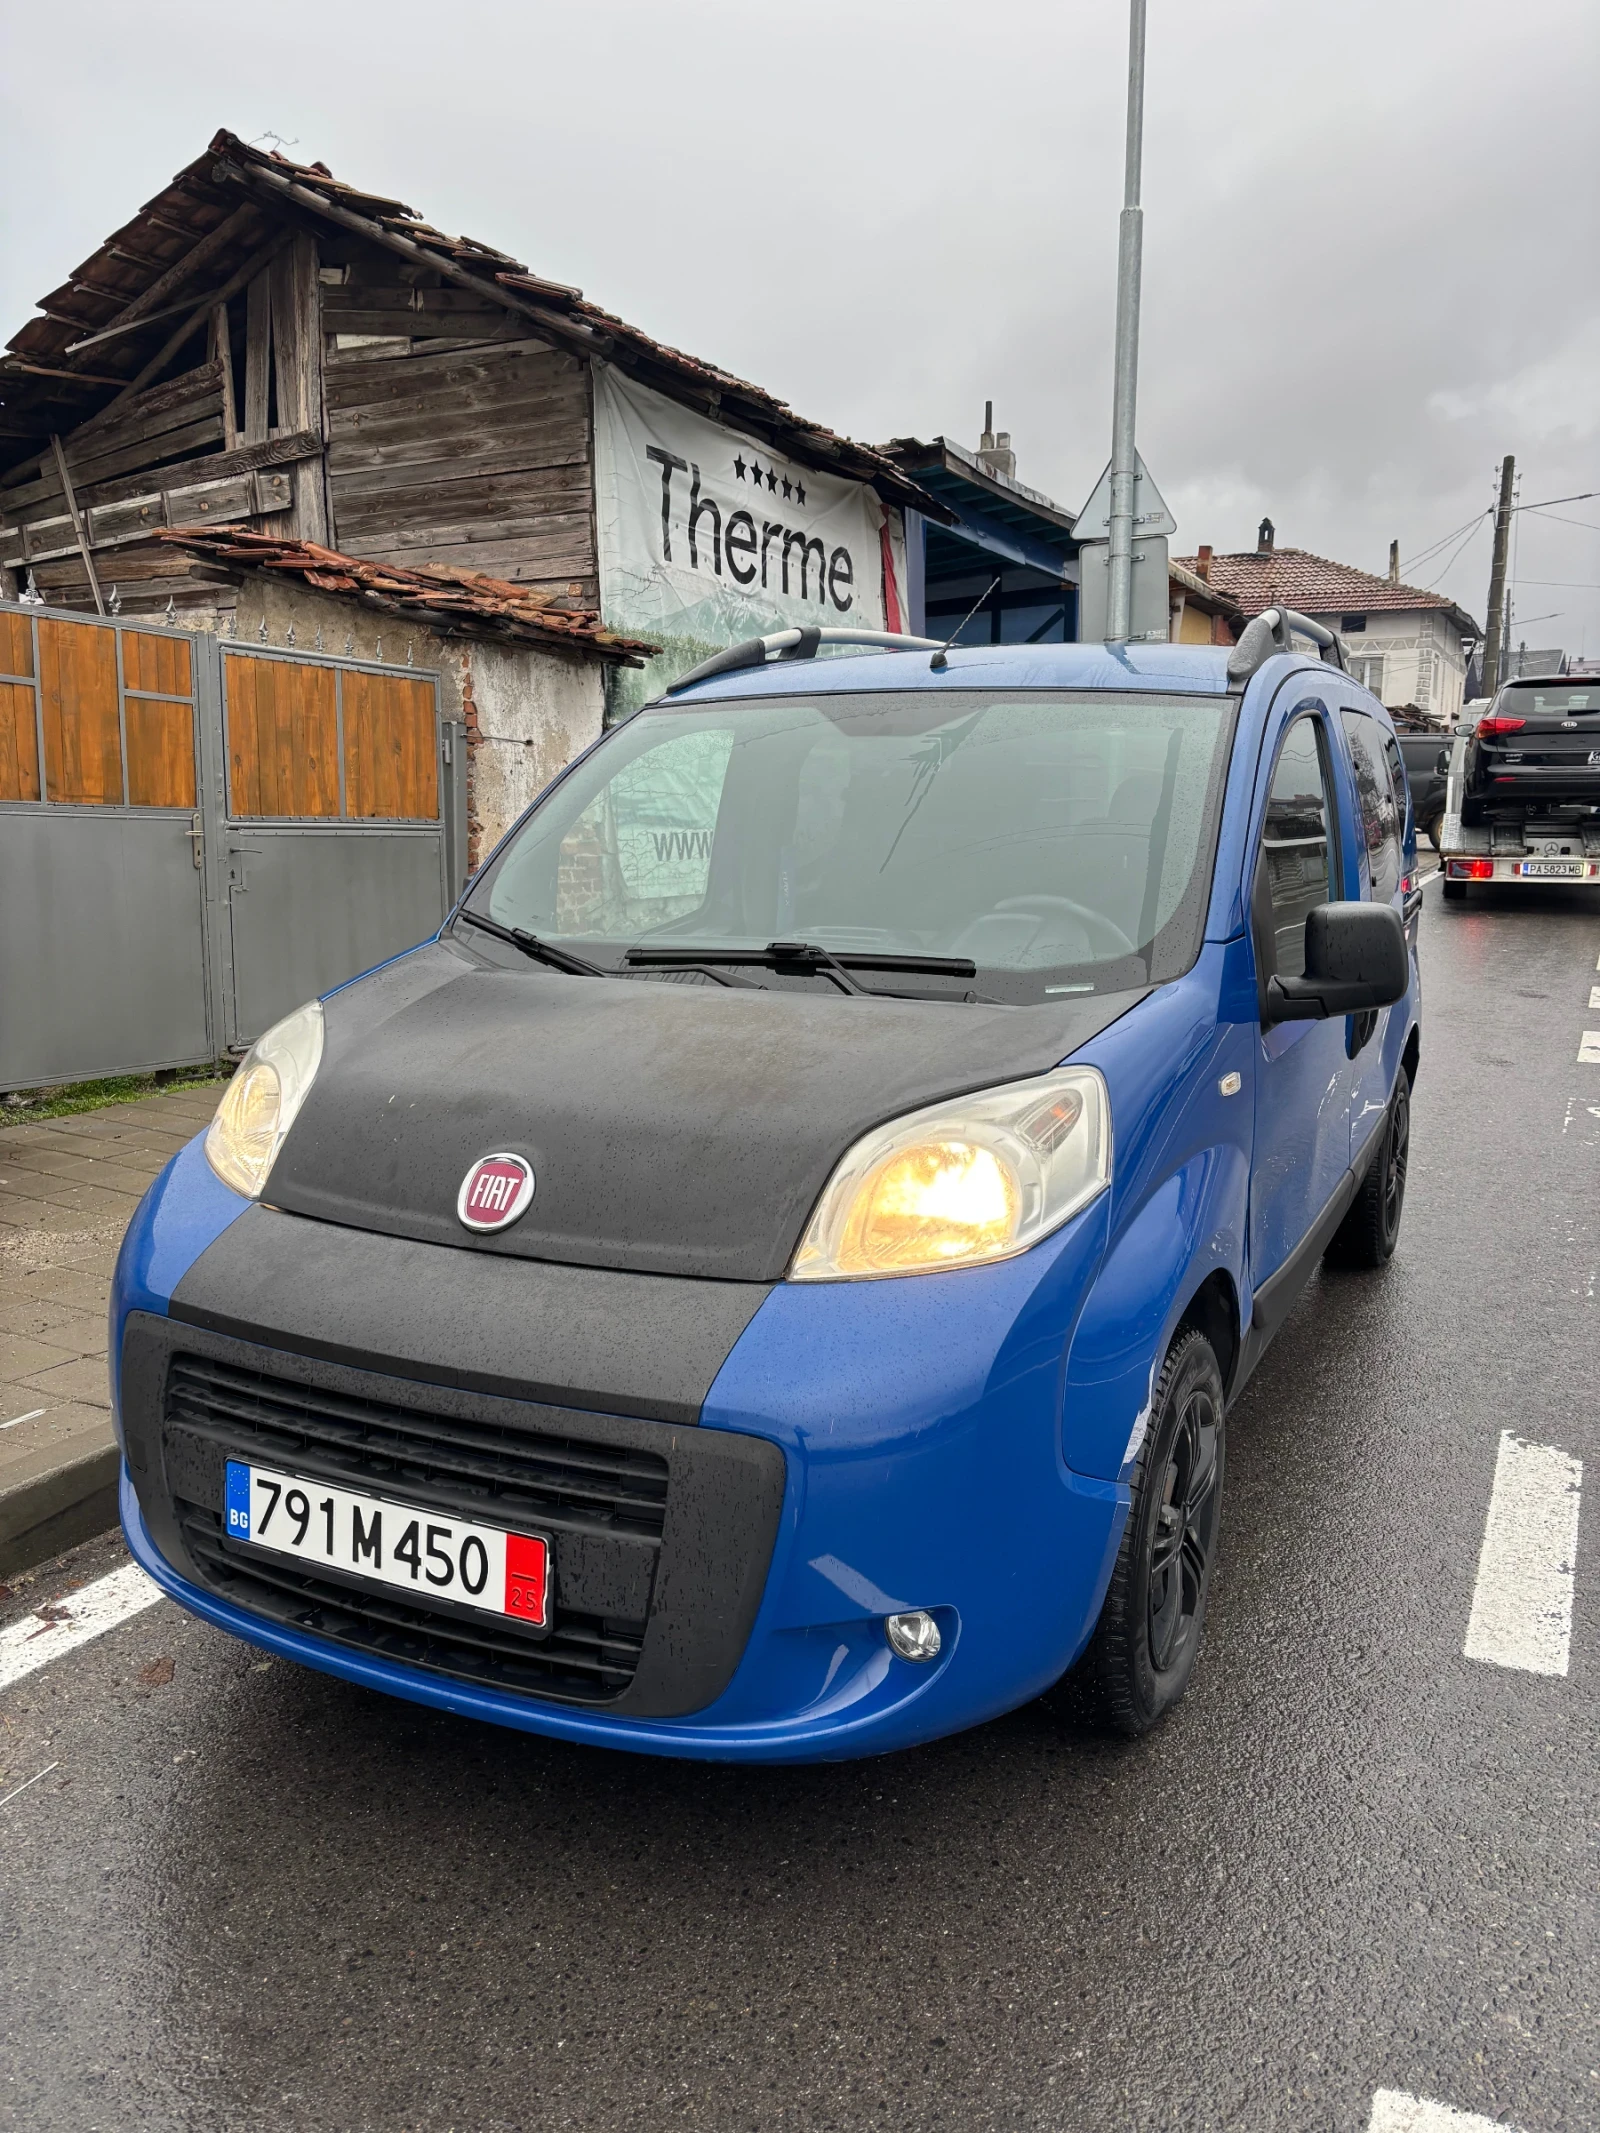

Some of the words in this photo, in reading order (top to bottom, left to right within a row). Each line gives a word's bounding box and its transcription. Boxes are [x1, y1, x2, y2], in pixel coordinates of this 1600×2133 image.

[646, 444, 854, 612] Therme
[1530, 865, 1542, 874] PA
[1544, 865, 1567, 874] 5823
[1569, 865, 1581, 875] MB
[470, 1174, 520, 1211] FIAT
[230, 1508, 248, 1529] BG
[256, 1478, 334, 1556] 791
[352, 1505, 382, 1569] M
[393, 1520, 489, 1595] 450
[511, 1587, 536, 1610] 25
